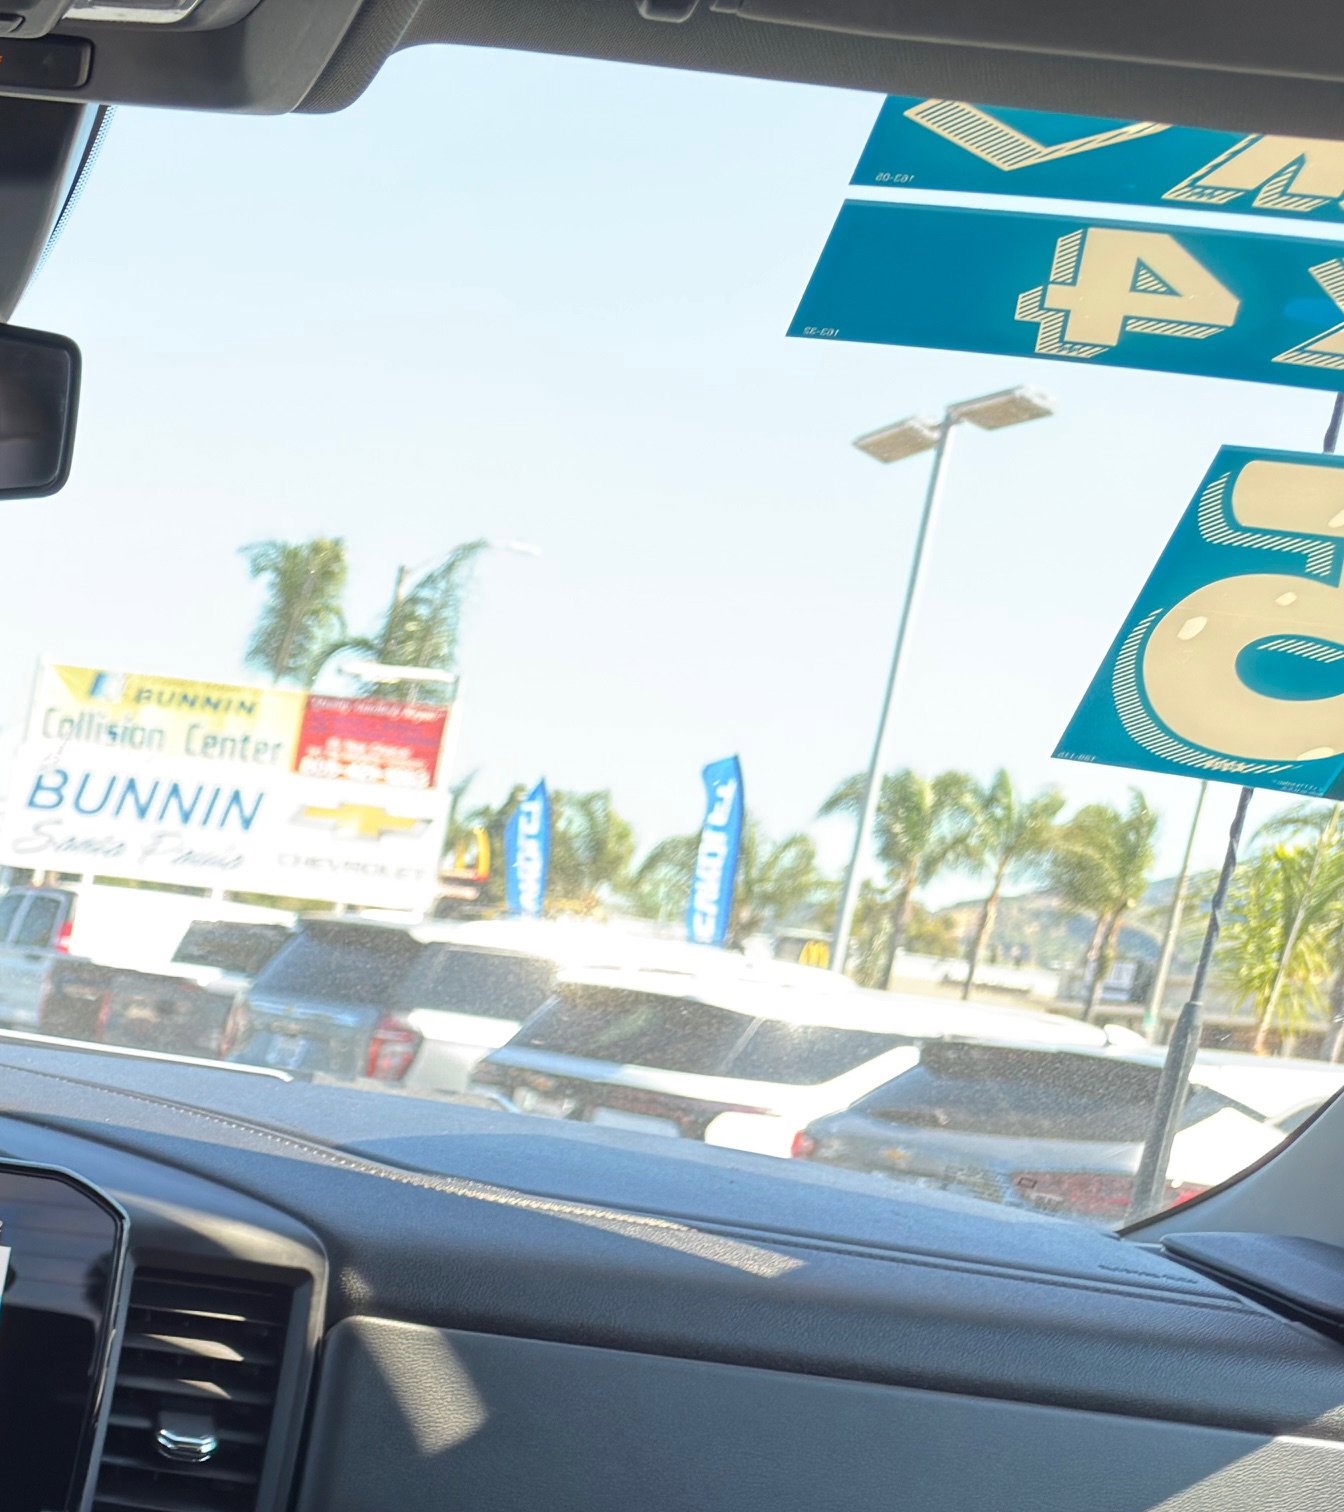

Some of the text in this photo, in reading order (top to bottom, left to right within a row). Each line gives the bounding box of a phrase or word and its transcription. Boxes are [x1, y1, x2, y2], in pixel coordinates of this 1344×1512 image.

[42, 707, 164, 750] Collision
[185, 725, 286, 764] Center
[27, 768, 265, 831] BUNNIN
